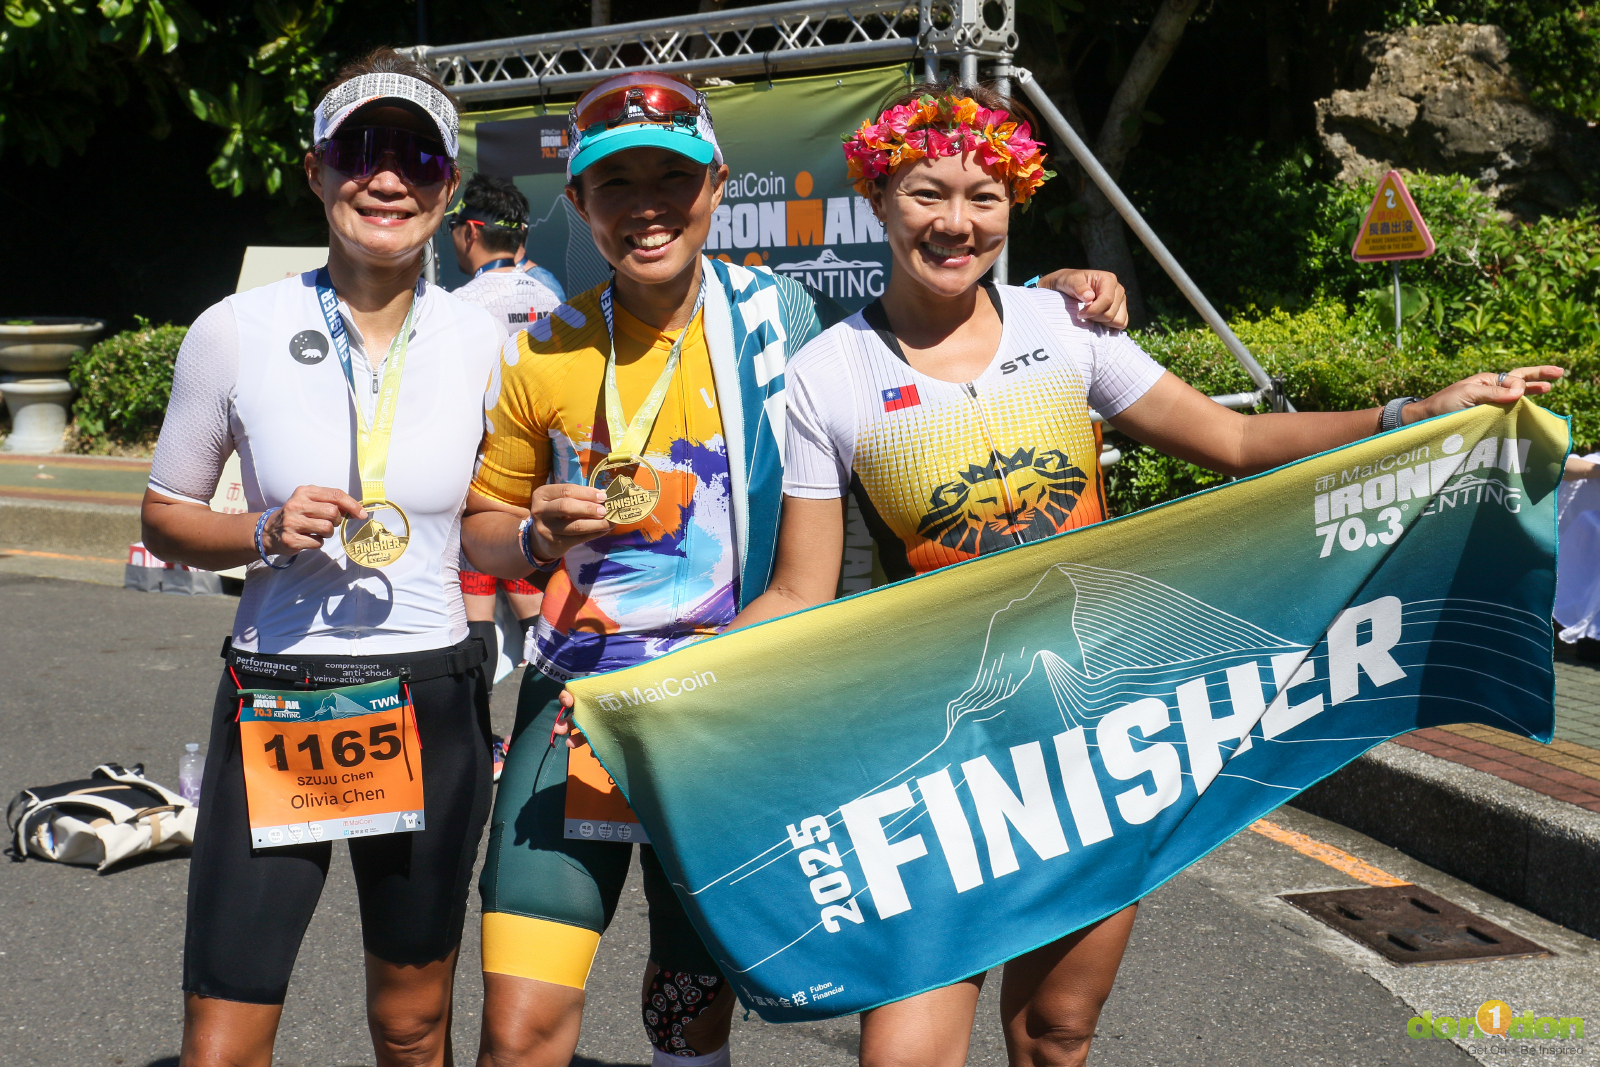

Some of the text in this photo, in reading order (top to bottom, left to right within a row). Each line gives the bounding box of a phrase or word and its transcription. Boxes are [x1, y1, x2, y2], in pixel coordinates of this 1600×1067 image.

[541, 134, 568, 147] IRONM
[725, 171, 786, 199] aiCoin
[702, 194, 884, 250] RONMAN
[782, 269, 885, 298] ENTING
[320, 288, 349, 363] FINISHER
[1000, 348, 1050, 375] STC
[1341, 445, 1430, 485] MaiCoin
[604, 492, 651, 511] FINISHER
[1315, 507, 1405, 559] 70.3
[354, 538, 401, 555] FINISHER
[236, 656, 298, 672] performance
[241, 664, 278, 676] recovery
[325, 663, 380, 671] compressport
[342, 668, 392, 677] anti-shock
[314, 675, 366, 684] veino-active
[620, 670, 718, 708] MaiCoin
[369, 694, 400, 710] TWN
[253, 708, 273, 717] 70.3
[274, 711, 301, 719] KENTING
[264, 722, 402, 772] 1165
[839, 595, 1408, 920] FINISHER
[297, 770, 374, 786] SZUJU Chen
[291, 786, 386, 809] Olivia Chen
[787, 813, 865, 933] 2025
[810, 981, 833, 994] Fubon
[812, 984, 845, 1001] Financial
